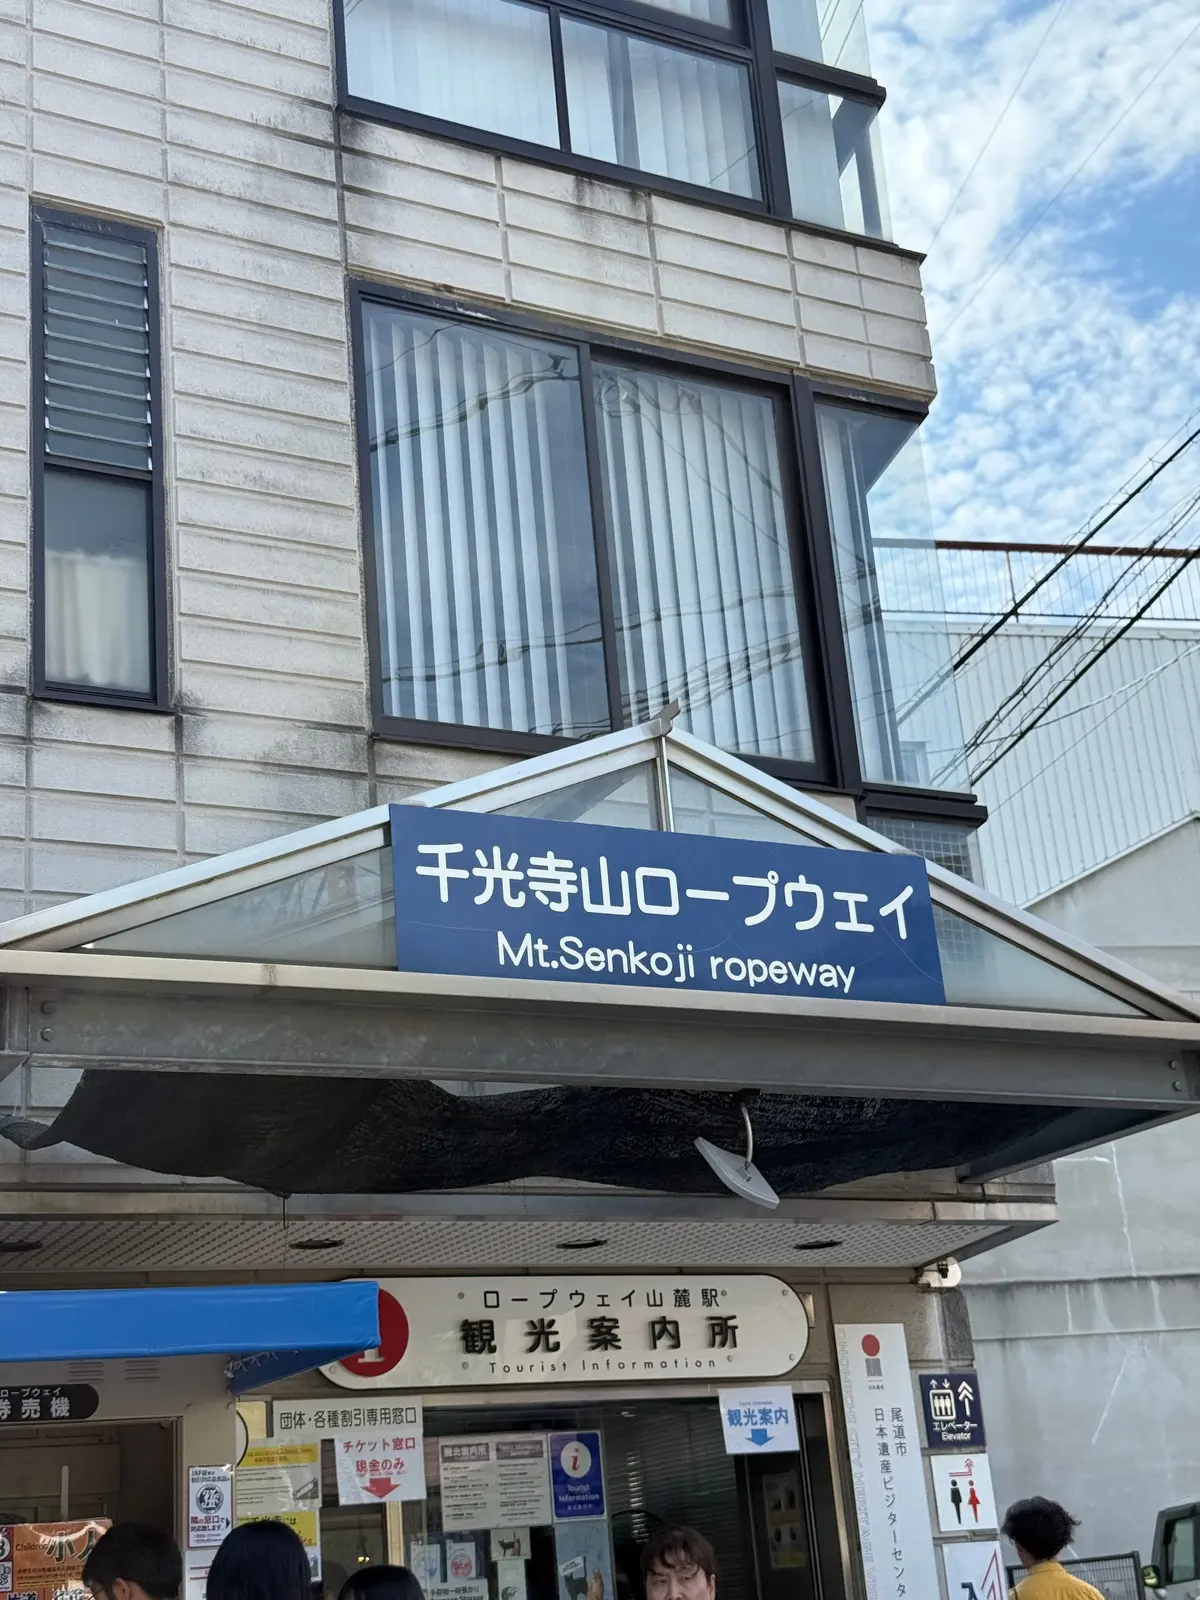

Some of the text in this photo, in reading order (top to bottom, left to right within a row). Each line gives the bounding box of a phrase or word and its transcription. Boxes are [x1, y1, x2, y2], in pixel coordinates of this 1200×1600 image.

[416, 843, 914, 940] 千光寺山ロープウェイ
[497, 930, 855, 993] Mt.Senkoji ropeway
[483, 1288, 720, 1309] ロープウェイ山麓駅
[460, 1314, 739, 1355] 観光案内所
[488, 1357, 716, 1374] Tourist Information
[280, 1407, 416, 1430] 団体・各種割引専用窓口
[727, 1407, 789, 1427] 観光案内
[932, 1421, 978, 1431] エレベーター
[891, 1407, 907, 1456] 尾道市
[941, 1432, 972, 1441] Elevator
[343, 1437, 416, 1453] チケット窓口
[355, 1458, 405, 1473] 現金のみ
